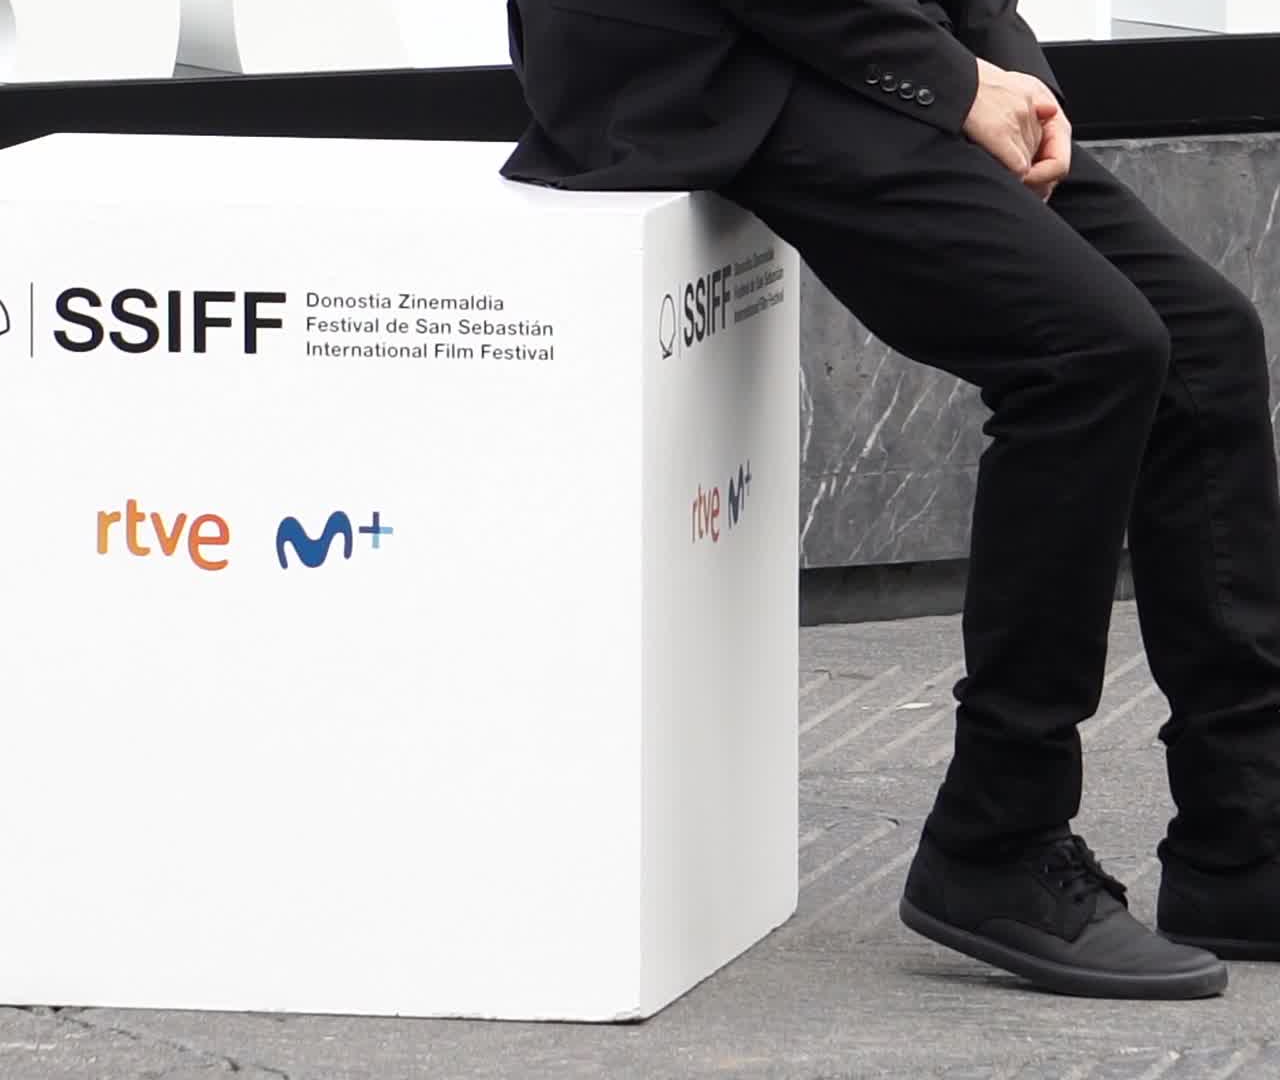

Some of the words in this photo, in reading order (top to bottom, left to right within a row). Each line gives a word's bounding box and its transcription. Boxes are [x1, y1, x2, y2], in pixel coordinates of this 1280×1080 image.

[52, 286, 287, 355] SSIFF
[306, 291, 392, 309] Donostia
[397, 293, 504, 312] Zinemaldia
[306, 316, 379, 333] Festival
[385, 318, 409, 334] de
[415, 318, 452, 335] San
[457, 318, 554, 337] Sebastián
[683, 264, 732, 348] SSIFF
[306, 340, 428, 359] International
[434, 342, 474, 360] Film
[480, 343, 554, 361] Festival
[96, 498, 232, 572] rtve
[691, 482, 721, 544] rtve
